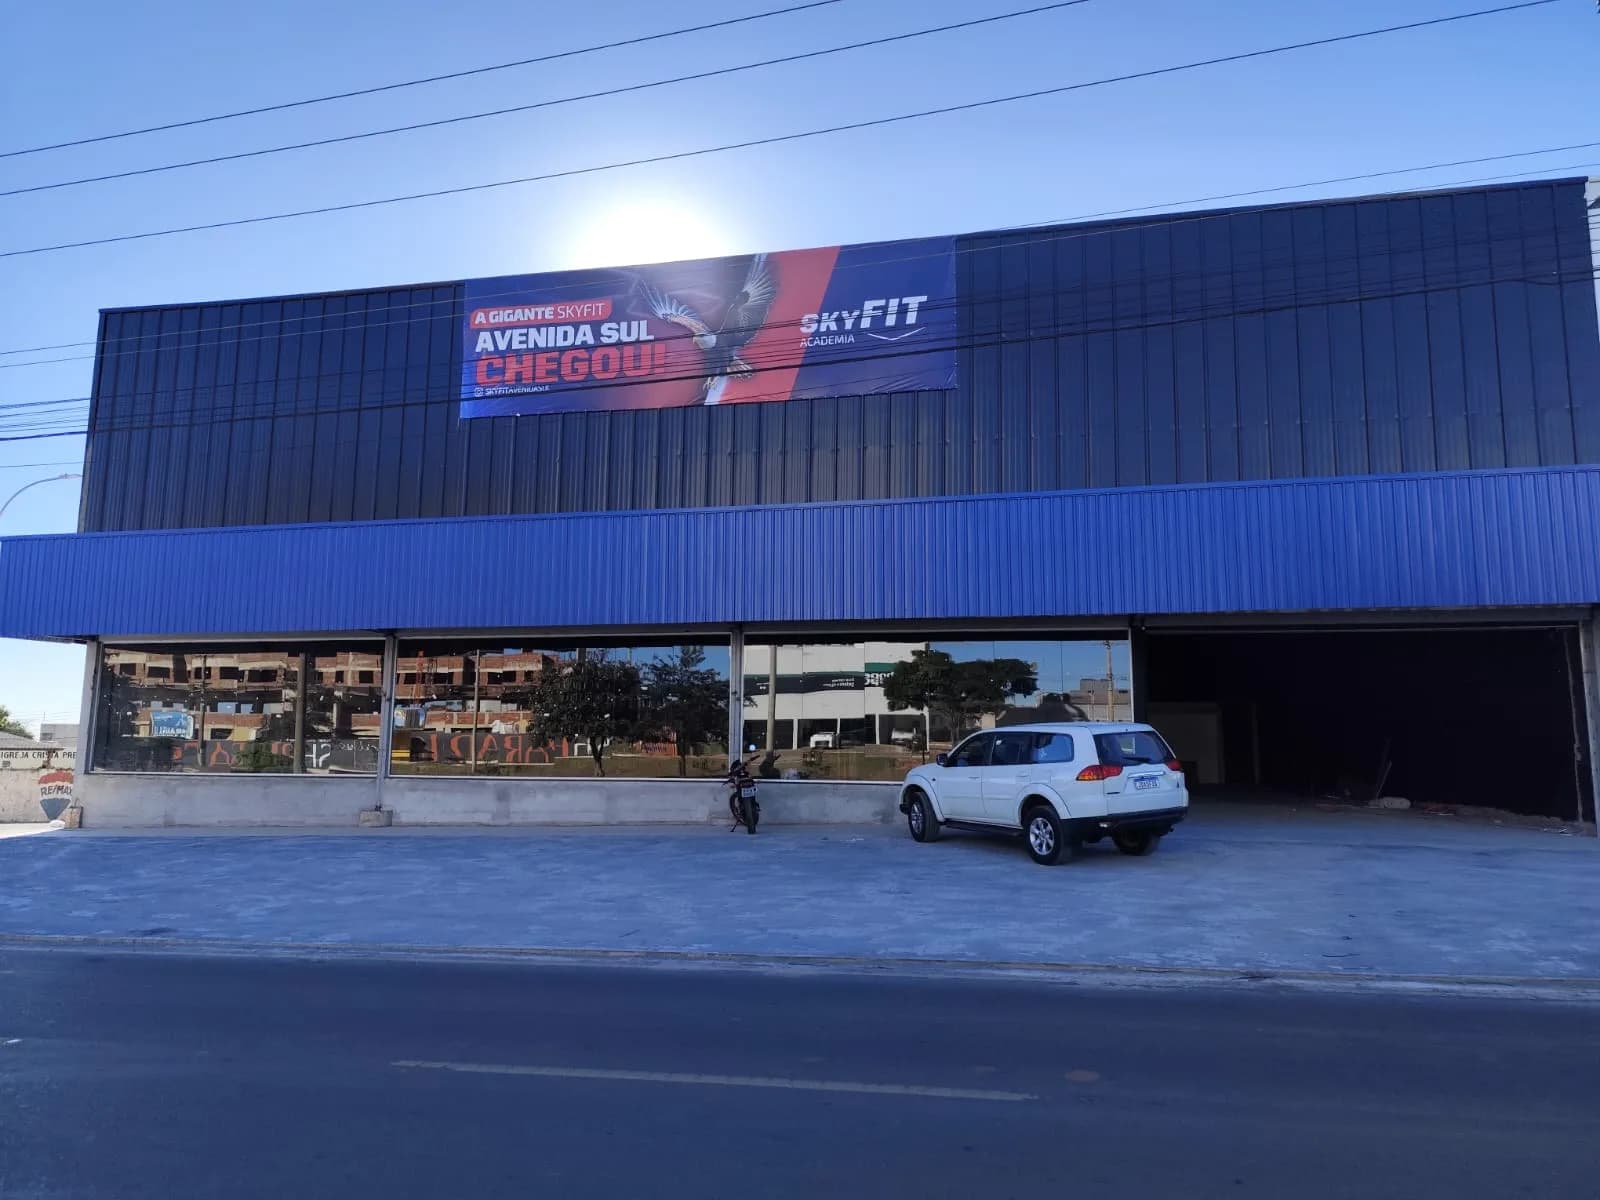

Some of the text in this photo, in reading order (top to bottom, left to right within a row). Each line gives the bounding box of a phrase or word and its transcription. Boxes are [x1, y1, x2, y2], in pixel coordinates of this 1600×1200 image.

[475, 303, 605, 324] A GIGANTE SKYFIT
[800, 295, 928, 333] SKYFIT
[475, 320, 655, 352] AVENIDA SUL
[800, 334, 855, 347] ACADEMIA
[476, 343, 667, 386] CHEGOU!
[1, 751, 29, 759] IGREJA
